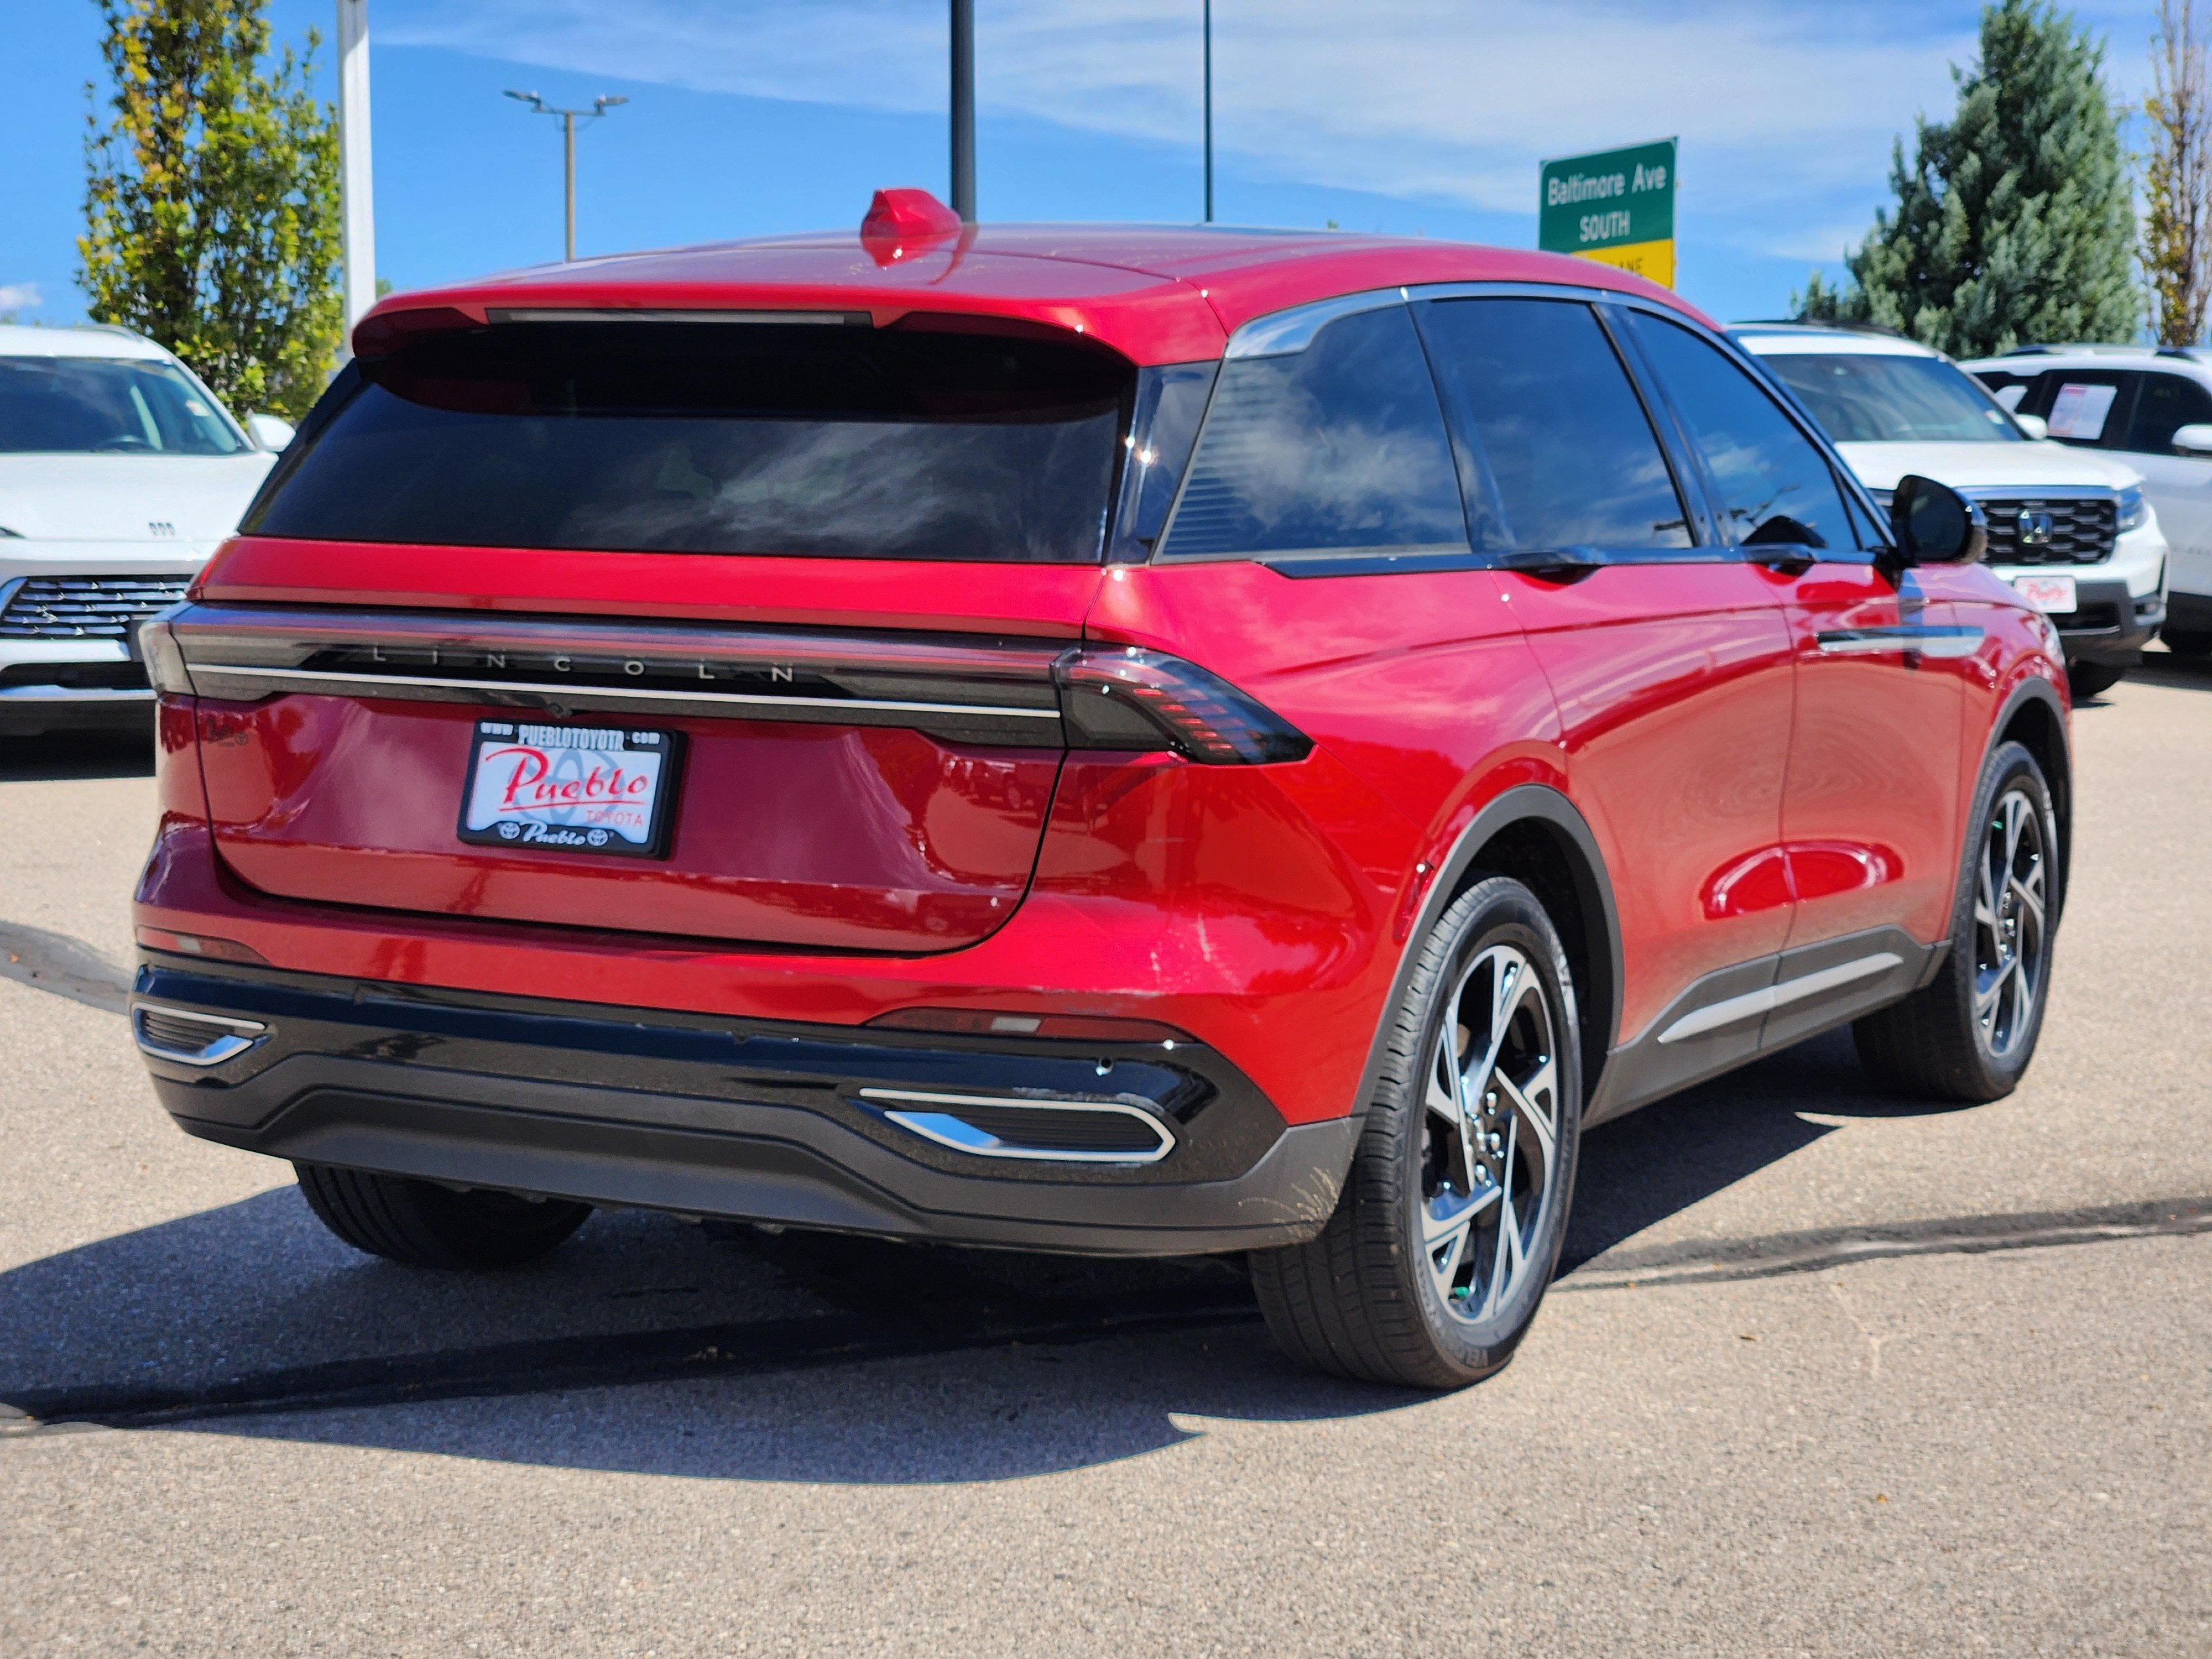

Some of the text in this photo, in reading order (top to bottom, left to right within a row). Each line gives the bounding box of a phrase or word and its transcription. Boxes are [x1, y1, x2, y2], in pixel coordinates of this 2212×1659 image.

[1548, 162, 1667, 207] Baltimore Ave
[1579, 210, 1631, 243] SOUTH
[373, 645, 794, 682] LINCOLN
[484, 745, 648, 804] Pueblo
[518, 820, 586, 846] Pueblo
[586, 810, 643, 826] TOYOTA
